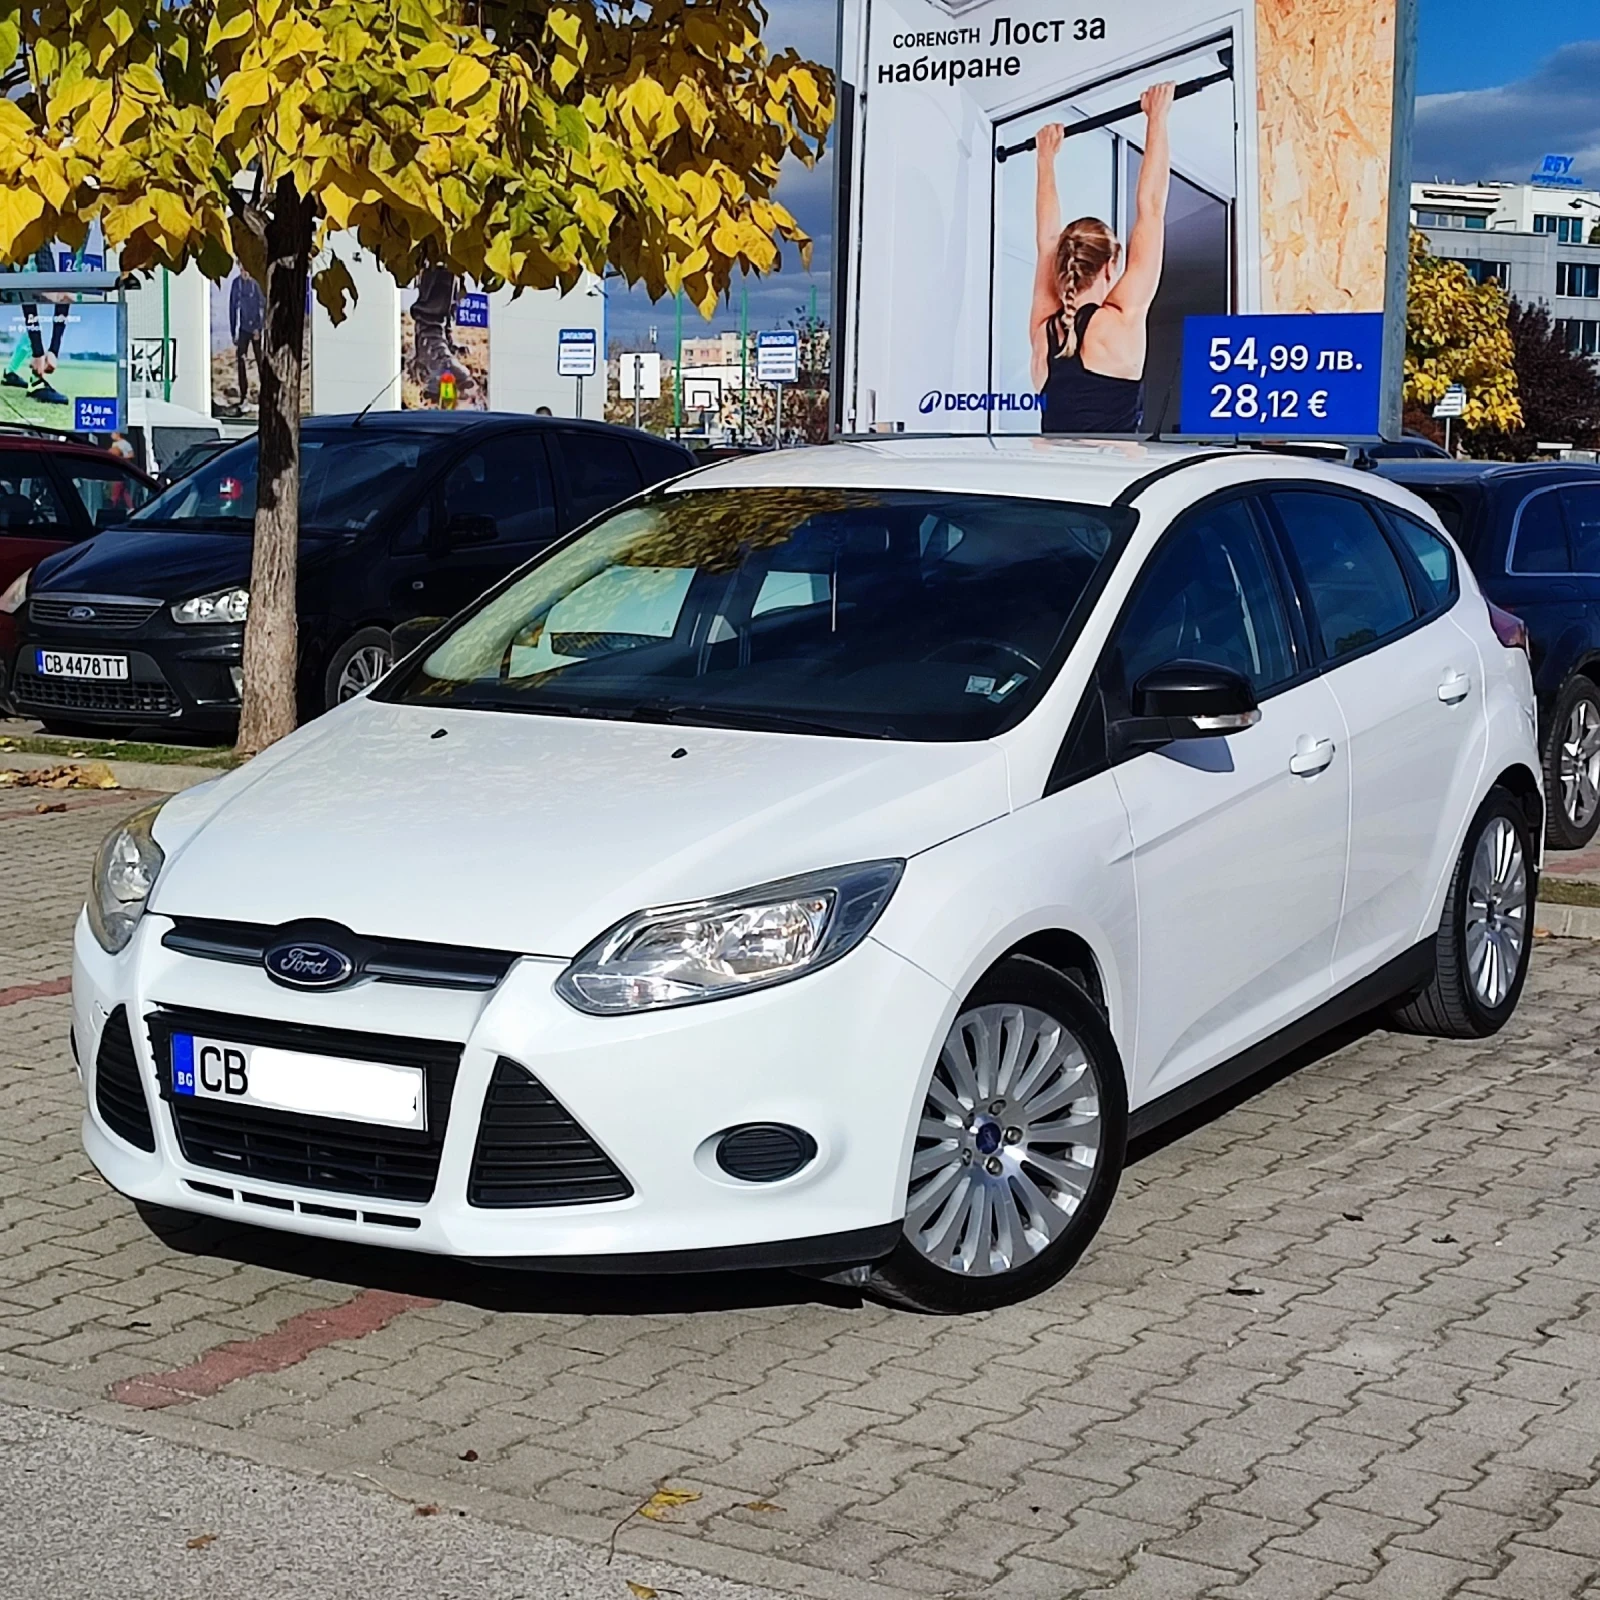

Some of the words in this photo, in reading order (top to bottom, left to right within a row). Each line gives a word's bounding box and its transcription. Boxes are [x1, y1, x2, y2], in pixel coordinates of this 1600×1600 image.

[893, 27, 980, 49] CORENGTH
[990, 17, 1065, 47] Лост
[1073, 17, 1105, 41] за
[877, 55, 1021, 86] набиране
[1208, 337, 1309, 378] 54,99
[1315, 350, 1363, 371] лв.
[944, 393, 1047, 411] DECATHLON
[1209, 383, 1299, 423] 28,12
[1307, 390, 1329, 418] €
[280, 948, 329, 975] Ford
[177, 1071, 193, 1087] BG
[200, 1045, 248, 1095] CB
